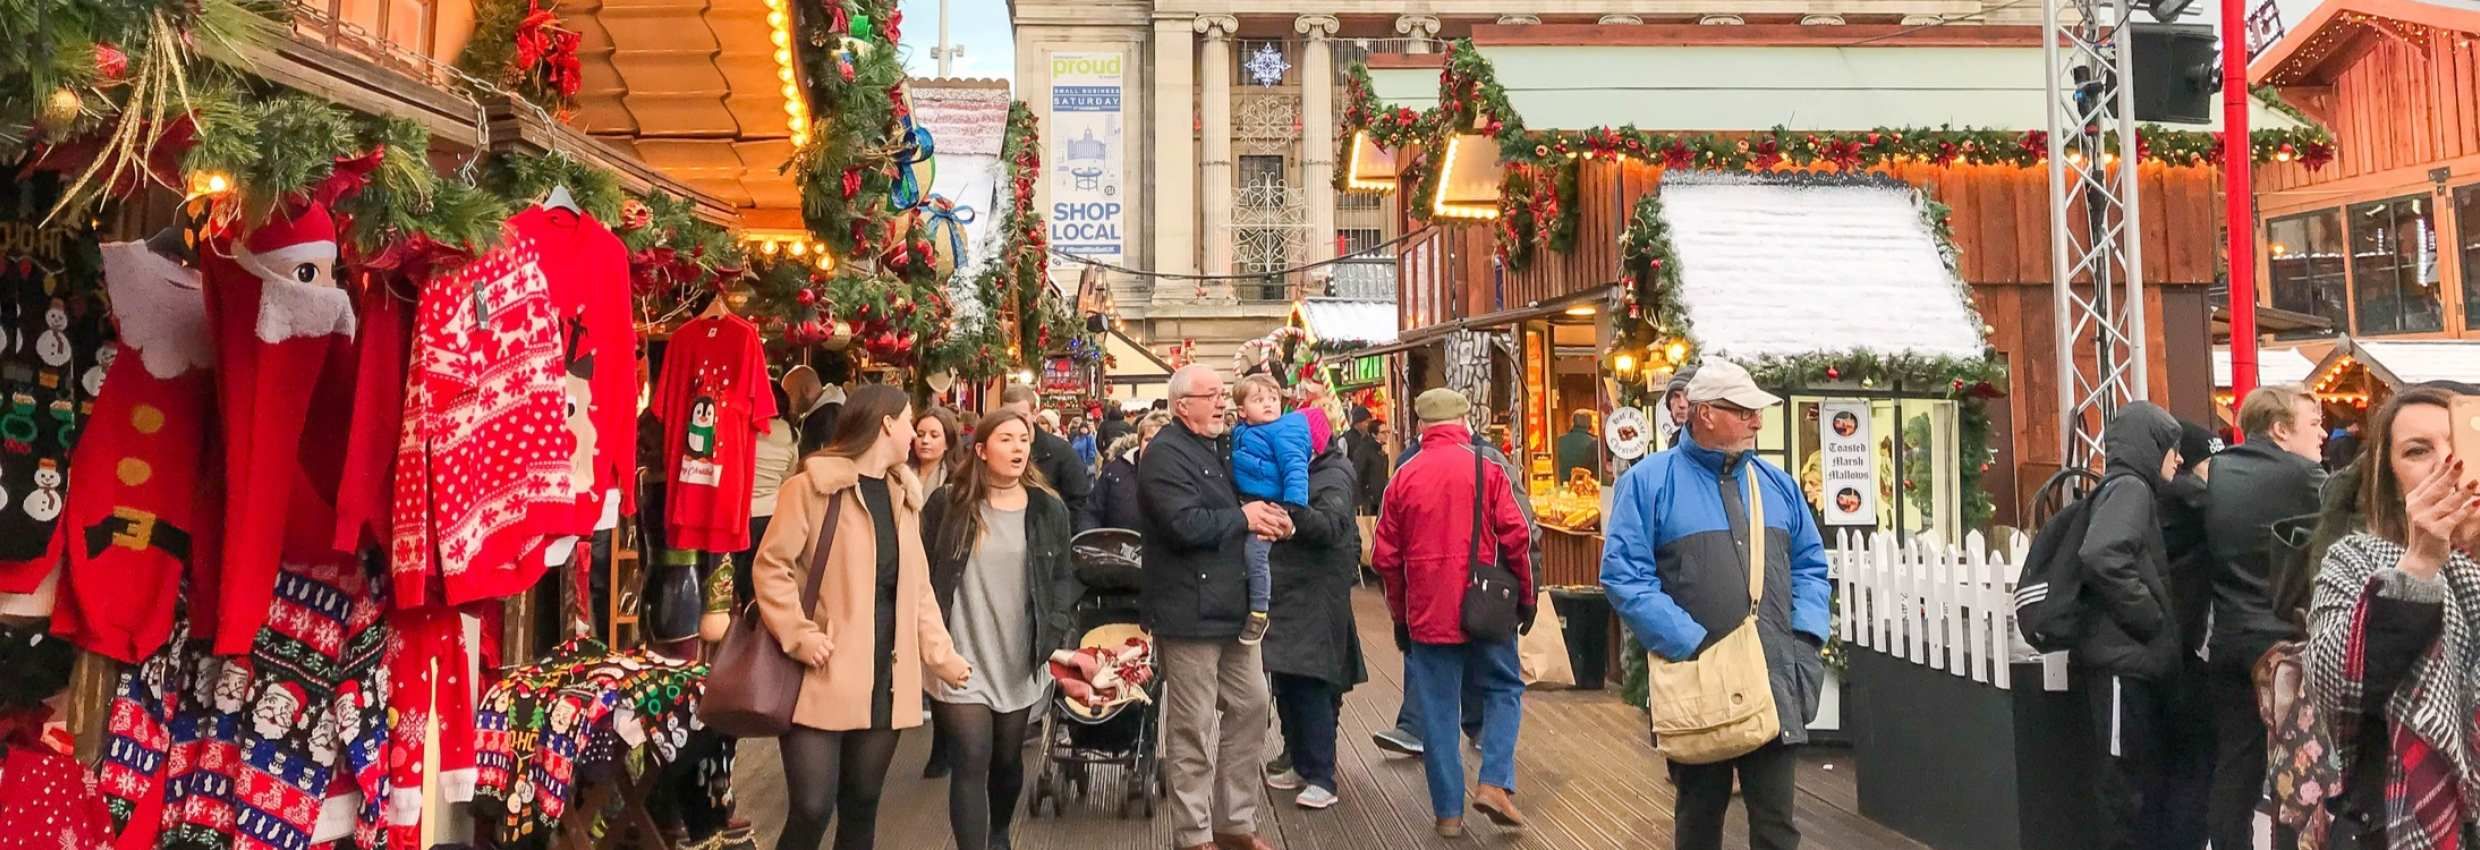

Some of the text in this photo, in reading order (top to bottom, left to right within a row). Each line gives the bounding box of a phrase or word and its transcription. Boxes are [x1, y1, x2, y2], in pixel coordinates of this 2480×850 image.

[1053, 55, 1120, 80] proud
[1053, 97, 1119, 105] SATURDAY
[1053, 202, 1120, 221] SHOP
[1052, 223, 1120, 240] LOCAL
[1828, 442, 1866, 453] Toasted
[1832, 456, 1864, 467] Marsh
[1828, 470, 1868, 480] Mallows
